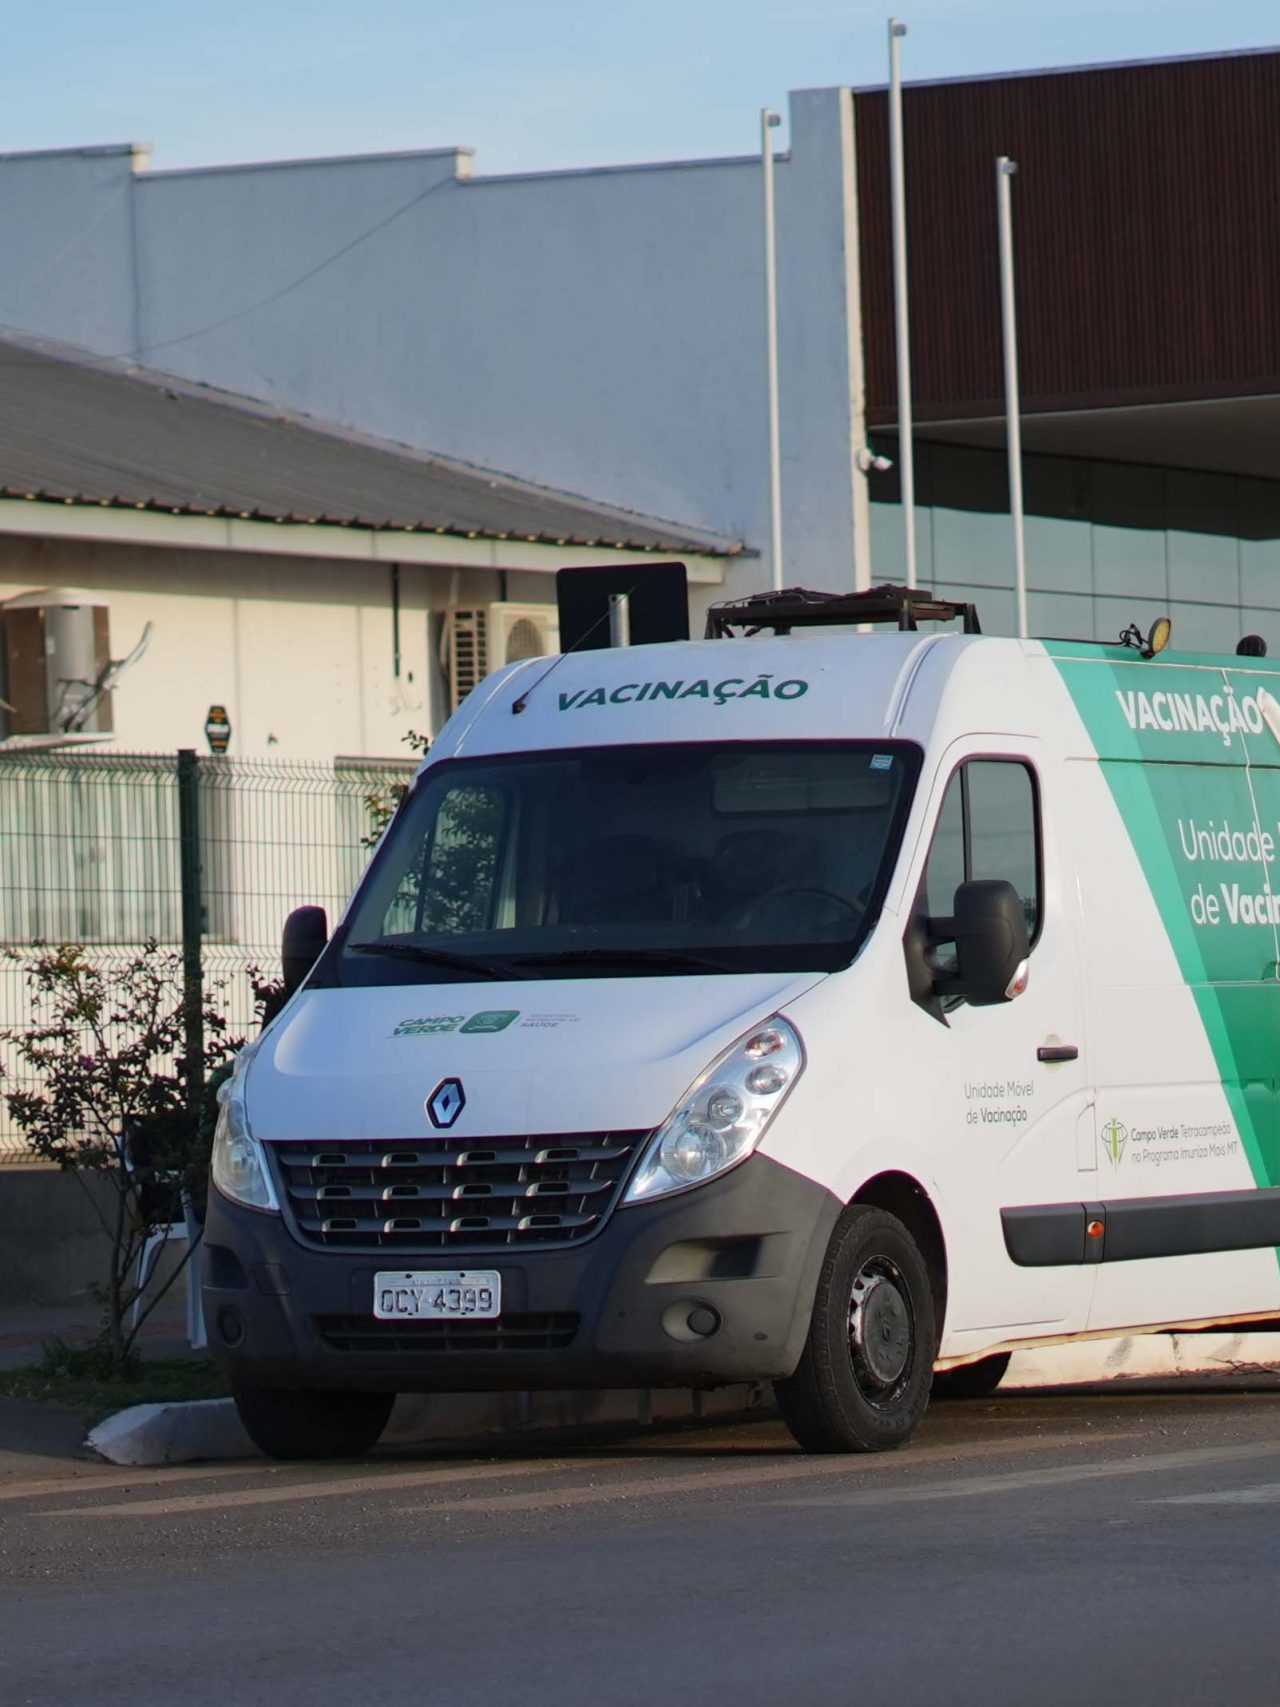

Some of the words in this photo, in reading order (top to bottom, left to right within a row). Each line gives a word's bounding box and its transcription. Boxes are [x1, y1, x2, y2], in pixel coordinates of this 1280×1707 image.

[558, 674, 809, 711] VACINAÇÃO
[1115, 685, 1264, 746] VACINAÇÃO
[1178, 819, 1276, 861] Unidade
[1191, 883, 1219, 924] de
[393, 1024, 460, 1035] VERDE
[398, 1015, 465, 1026] CAMPO
[964, 1080, 1005, 1099] Unidade
[1006, 1080, 1034, 1097] Móvel
[966, 1108, 978, 1124] de
[980, 1105, 1028, 1127] Vacinação
[1131, 1128, 1157, 1144] Campo
[1158, 1126, 1179, 1140] Verde
[1143, 1148, 1179, 1167] Programa
[1180, 1145, 1208, 1160] Imuniza
[1209, 1143, 1226, 1157] Mais
[1227, 1141, 1238, 1156] MT
